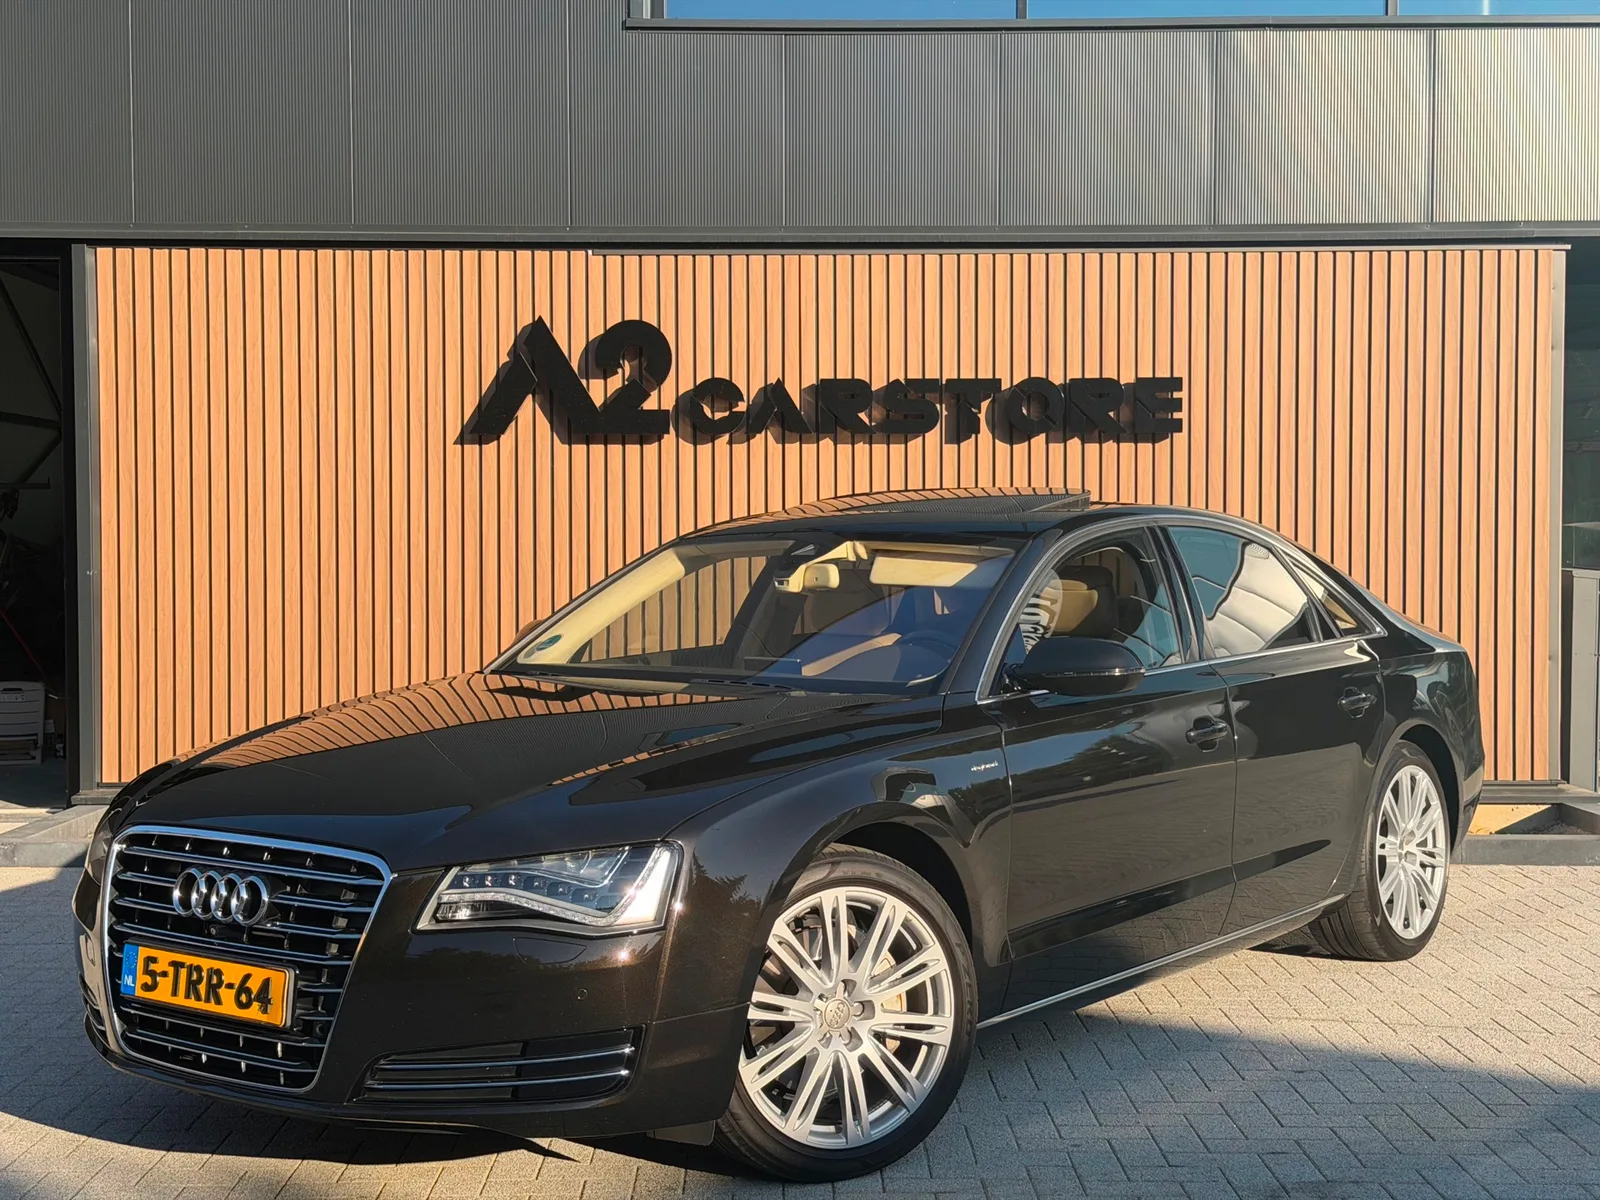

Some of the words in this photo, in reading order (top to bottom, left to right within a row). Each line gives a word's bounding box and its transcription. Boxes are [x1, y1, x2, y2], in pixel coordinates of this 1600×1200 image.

[464, 315, 672, 435] A2
[690, 377, 1184, 435] CARSTORE
[124, 974, 136, 987] NL
[140, 955, 273, 1015] 5-TRR-64
